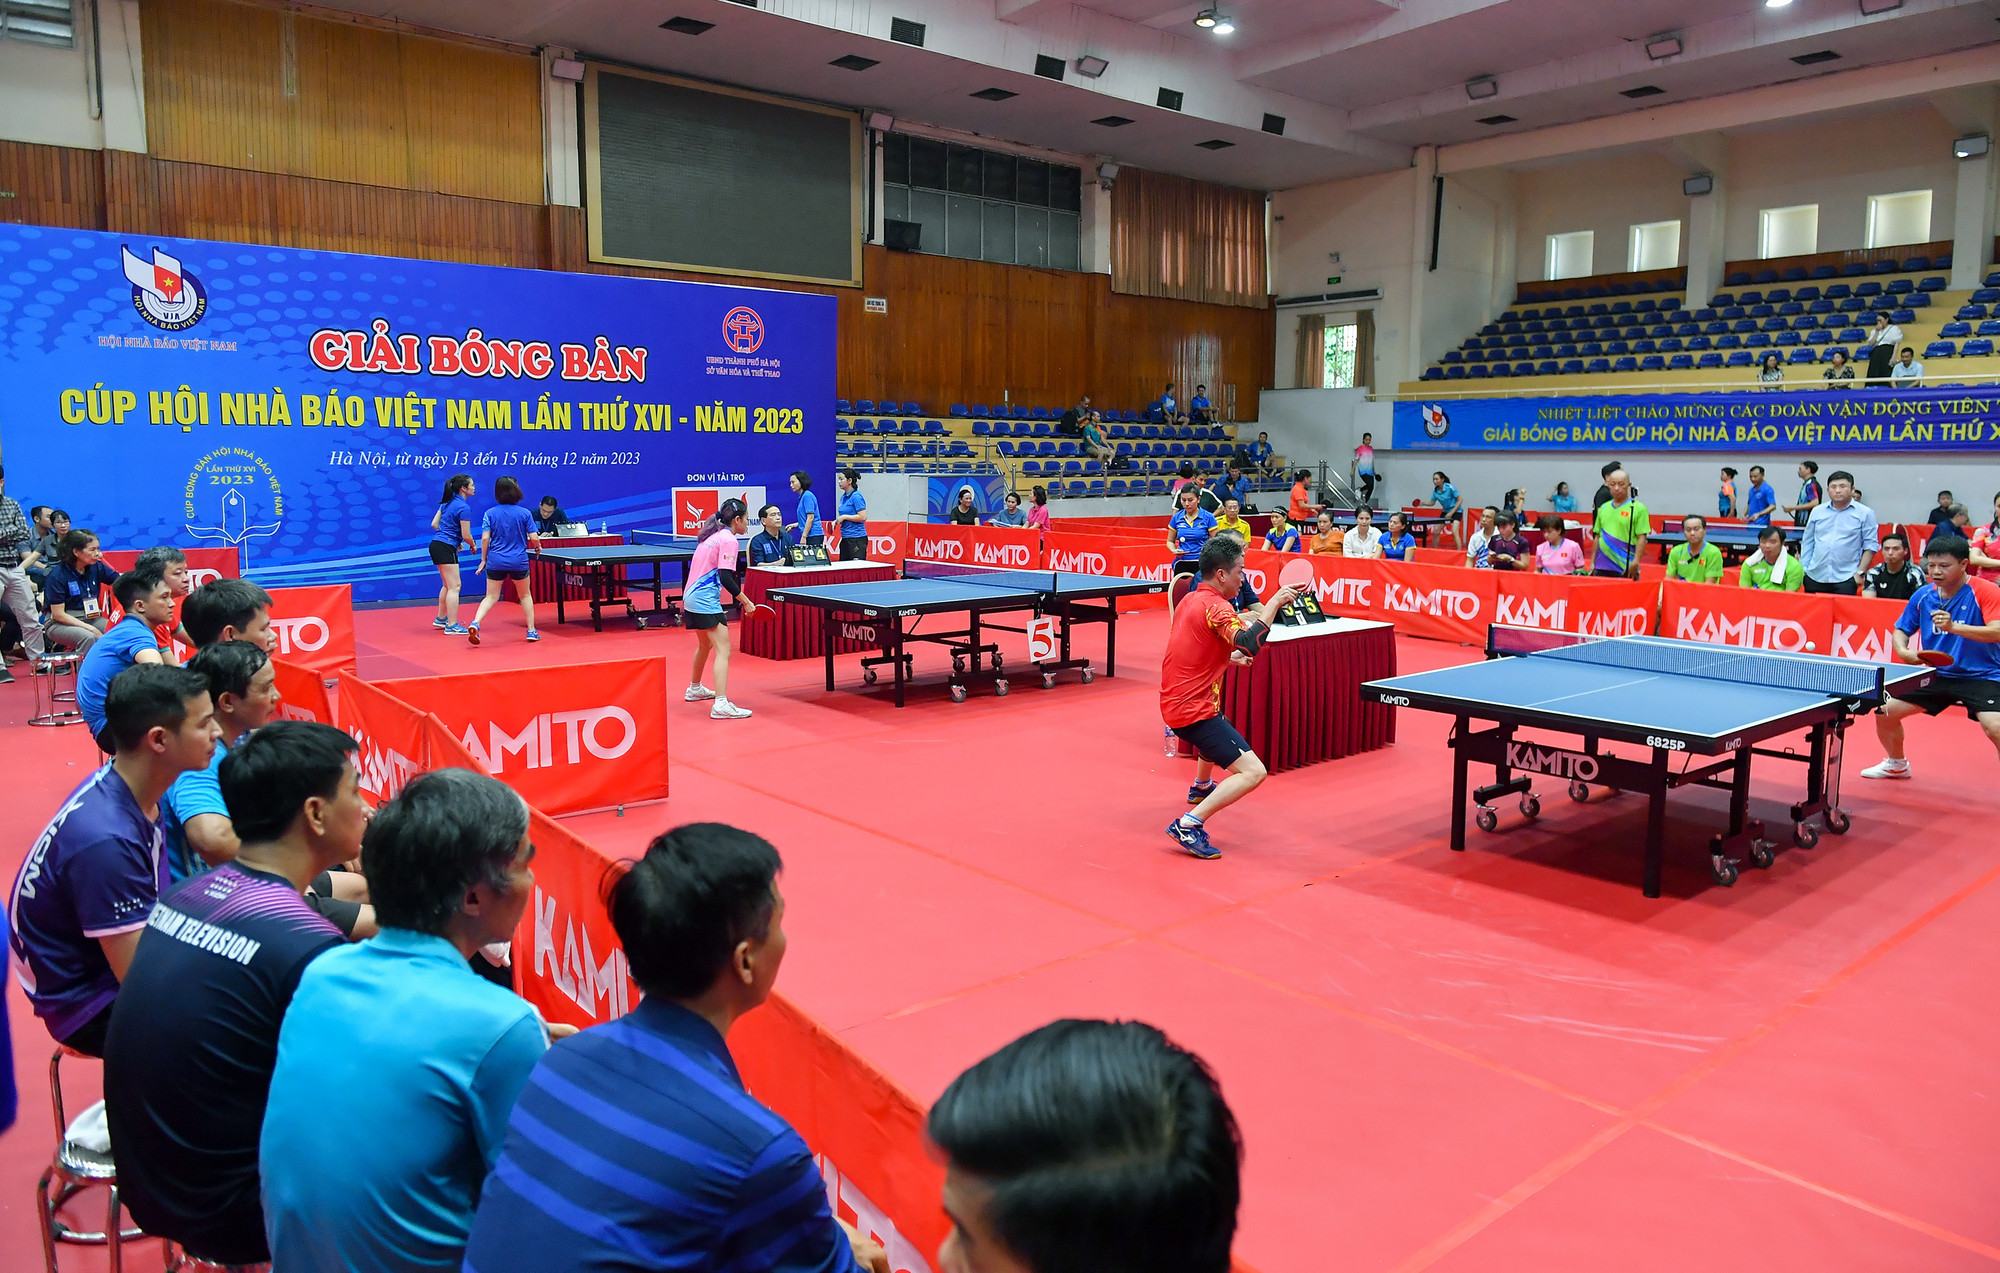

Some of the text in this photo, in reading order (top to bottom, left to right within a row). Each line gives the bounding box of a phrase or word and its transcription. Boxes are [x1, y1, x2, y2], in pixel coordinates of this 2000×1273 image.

[197, 298, 205, 316] NAM
[98, 335, 237, 352] HỘI NHÀ BÁO VIỆT NAM
[310, 319, 648, 382] GIẢI BÓNG BÀN
[724, 356, 746, 366] THÀNH
[747, 357, 759, 366] PHỐ
[760, 358, 769, 367] HÀ
[770, 359, 780, 368] NỘI
[729, 367, 742, 376] HÓA
[742, 368, 751, 376] VÀ
[764, 370, 780, 378] THAO
[60, 382, 137, 425] CÚP
[149, 384, 210, 432] HỘI
[221, 387, 292, 426] NHÀ
[300, 388, 365, 427] BÁO
[374, 391, 437, 435] VIỆT
[446, 399, 512, 430] NAM
[520, 392, 571, 431] LẦN
[579, 395, 629, 431] THỨ
[633, 404, 672, 431] XVI
[695, 400, 747, 433] NĂM
[753, 408, 804, 434] 2023
[1537, 396, 1991, 421] NHIỆT LIỆT CHÀO MỪNG CÁC ĐOÀN VẬN ĐỘNG VIÊN
[1483, 423, 1516, 442] GIẢI
[1520, 423, 1568, 442] BÓNG
[1572, 422, 1606, 441] BÀN
[1611, 422, 1646, 441] CÚP
[1651, 422, 1683, 445] HỘI
[1689, 421, 1730, 442] NHÀ
[1735, 420, 1778, 442] BÁO
[1784, 421, 1825, 445] VIỆT
[1831, 424, 1882, 442] NAM
[1889, 417, 1934, 441] LẦN
[1940, 417, 1985, 441] THỨ
[206, 464, 223, 473] LẦN
[225, 464, 242, 473] THỨ
[329, 451, 641, 469] Hà Nội, từ ngày 13 đến 15 tháng 12 năm 2023
[184, 446, 283, 519] CÚP BÓNG BÀN HỘI NHÀ BÁO VIỆT NAM
[209, 475, 254, 485] 2023
[687, 472, 745, 483] ĐƠN VỊ TÀI TRỢ
[684, 520, 706, 529] KAMIT
[793, 550, 804, 561] 5
[816, 549, 825, 559] 4
[915, 538, 963, 560] KAMITO
[974, 543, 1030, 566] KAMITO
[1050, 549, 1107, 575] KAMITO
[1123, 564, 1172, 581] KAMIT
[1304, 597, 1317, 613] 5
[1384, 583, 1480, 620] KAMITO
[898, 608, 917, 616] KAMITO
[1496, 594, 1568, 630] KAMI
[842, 623, 876, 642] KAMITO
[1578, 607, 1648, 641] KAMITO
[1677, 607, 1807, 652] KAMITO
[1032, 623, 1052, 658] 5
[1380, 693, 1410, 706] KAMITO
[461, 705, 636, 774] AMITO
[1646, 735, 1686, 751] 6825P
[1725, 737, 1742, 751] KAMITO
[1506, 742, 1599, 782] KAMITO
[20, 801, 84, 900] XIOM
[175, 917, 262, 966] TELEVISION
[534, 884, 630, 1022] KAMI
